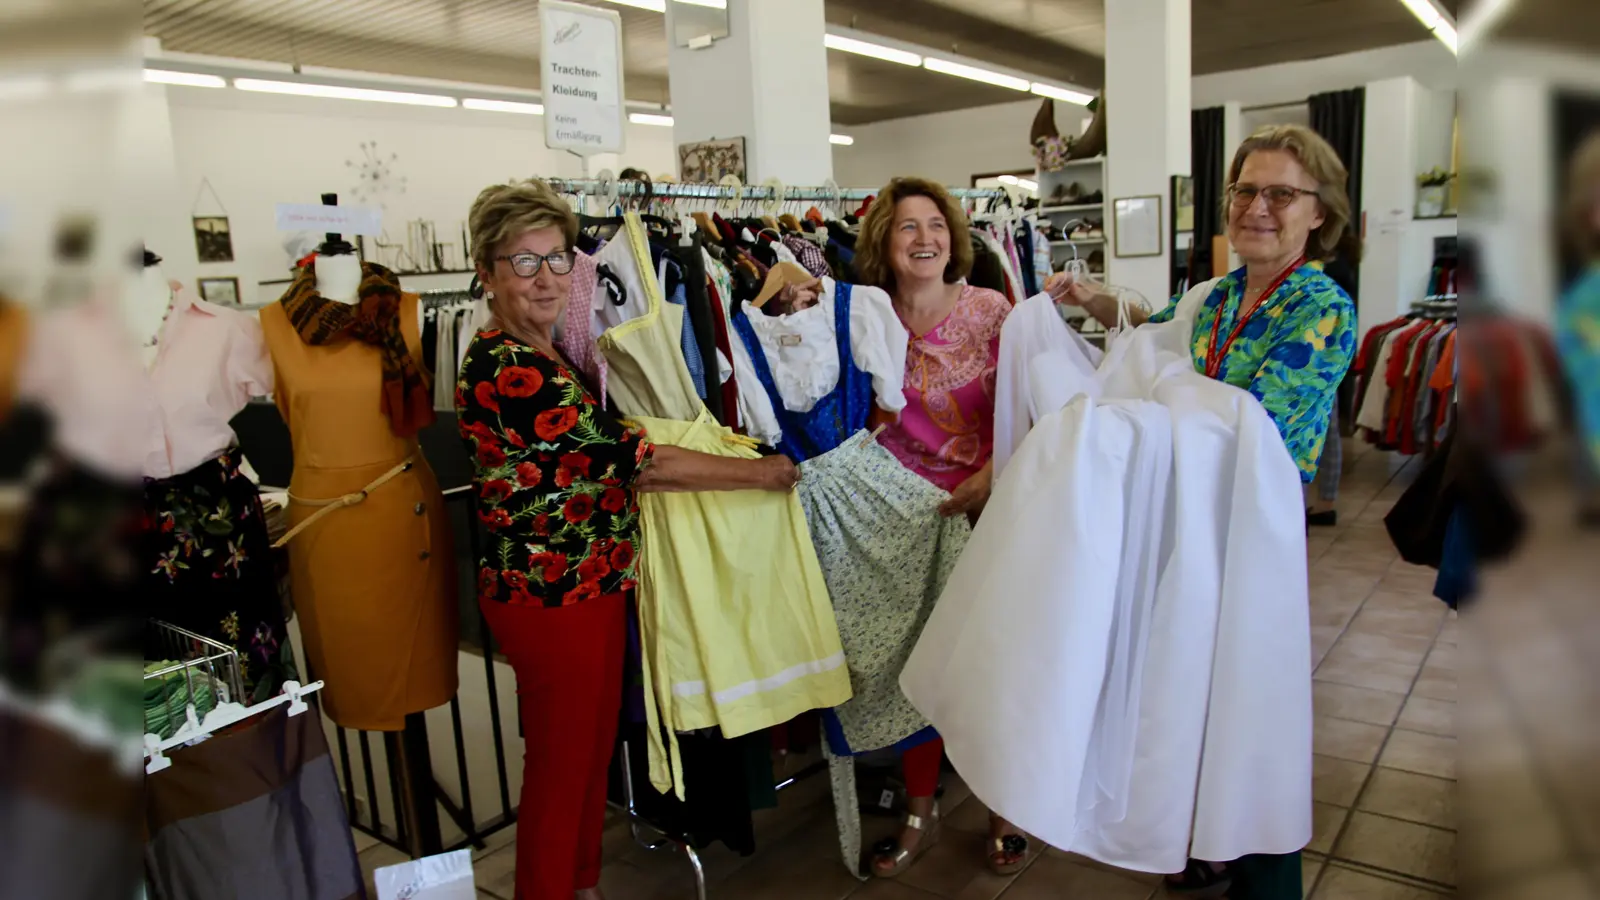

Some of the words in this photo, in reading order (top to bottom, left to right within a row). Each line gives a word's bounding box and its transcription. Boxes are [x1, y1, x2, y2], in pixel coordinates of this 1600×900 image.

[551, 62, 601, 78] Trachten-
[552, 84, 598, 101] Kleidung
[555, 114, 577, 125] Keine
